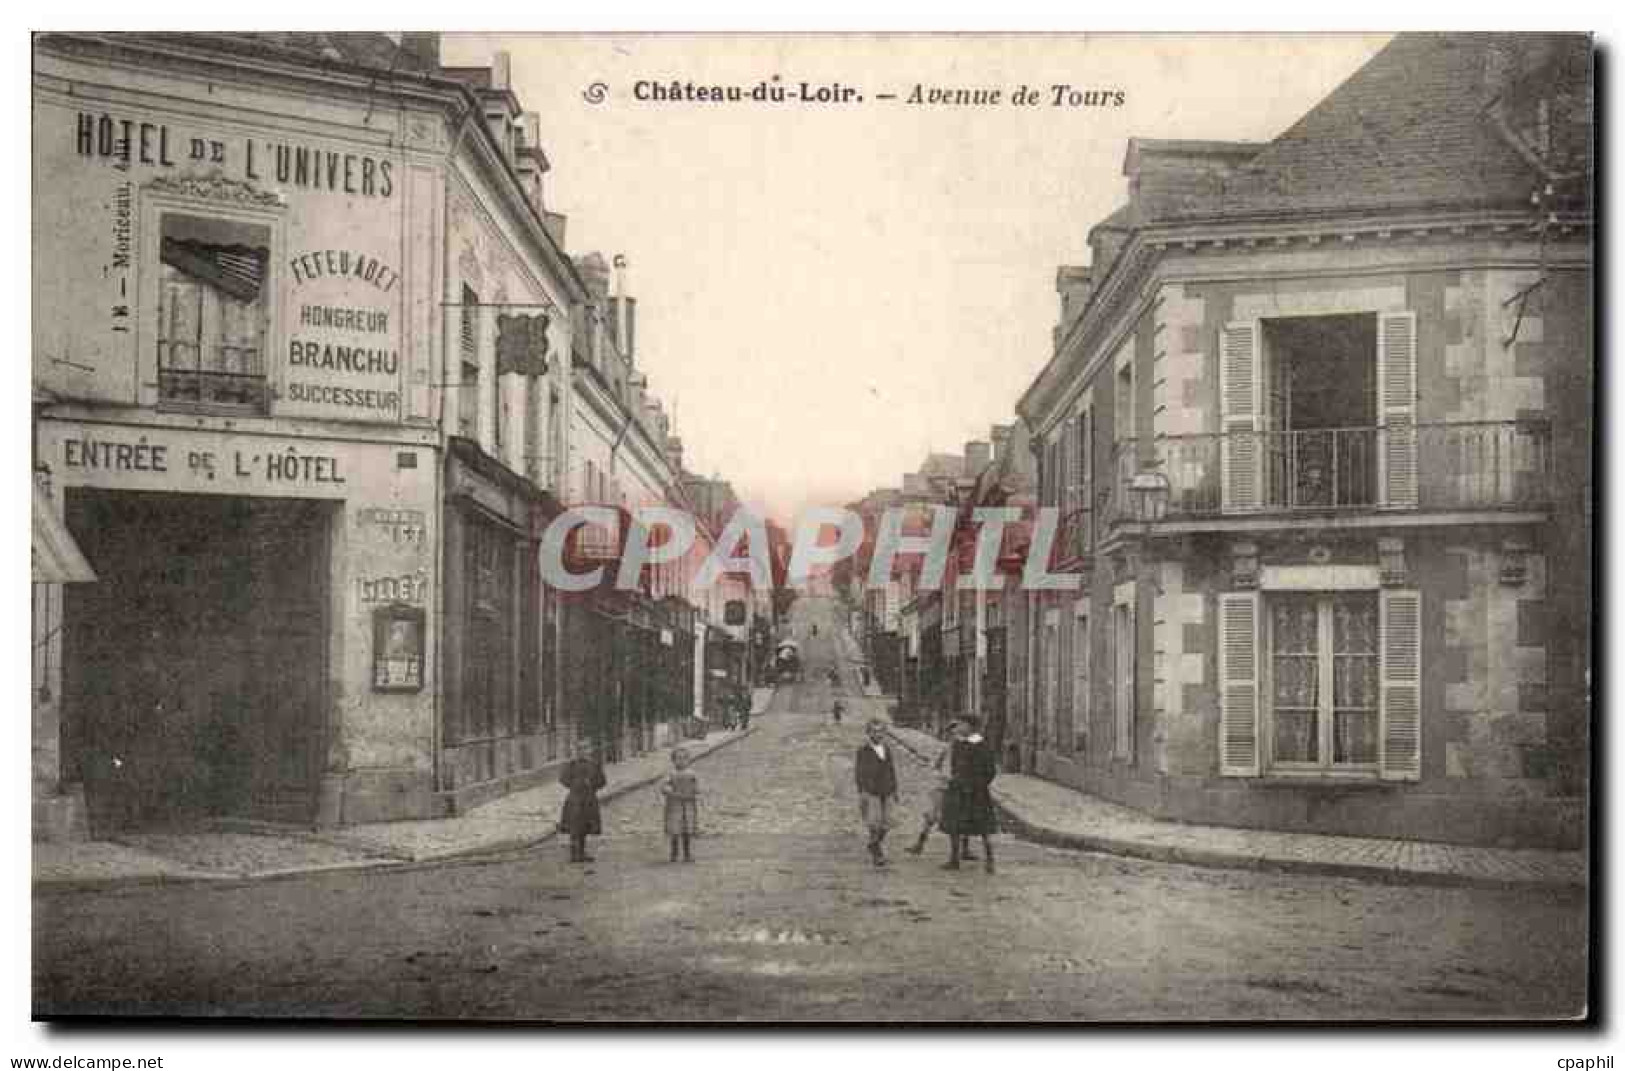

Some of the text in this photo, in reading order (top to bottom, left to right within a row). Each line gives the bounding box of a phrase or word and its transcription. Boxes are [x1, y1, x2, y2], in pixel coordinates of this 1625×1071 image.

[77, 111, 175, 166] HÔTEL
[191, 137, 223, 163] DE
[246, 138, 392, 197] L'UNIVERS
[289, 340, 398, 376] BRANCHU
[289, 382, 399, 411] SUCCESSEUR
[63, 436, 168, 472] ENTRÉE
[235, 446, 346, 484] L'HÔTEL
